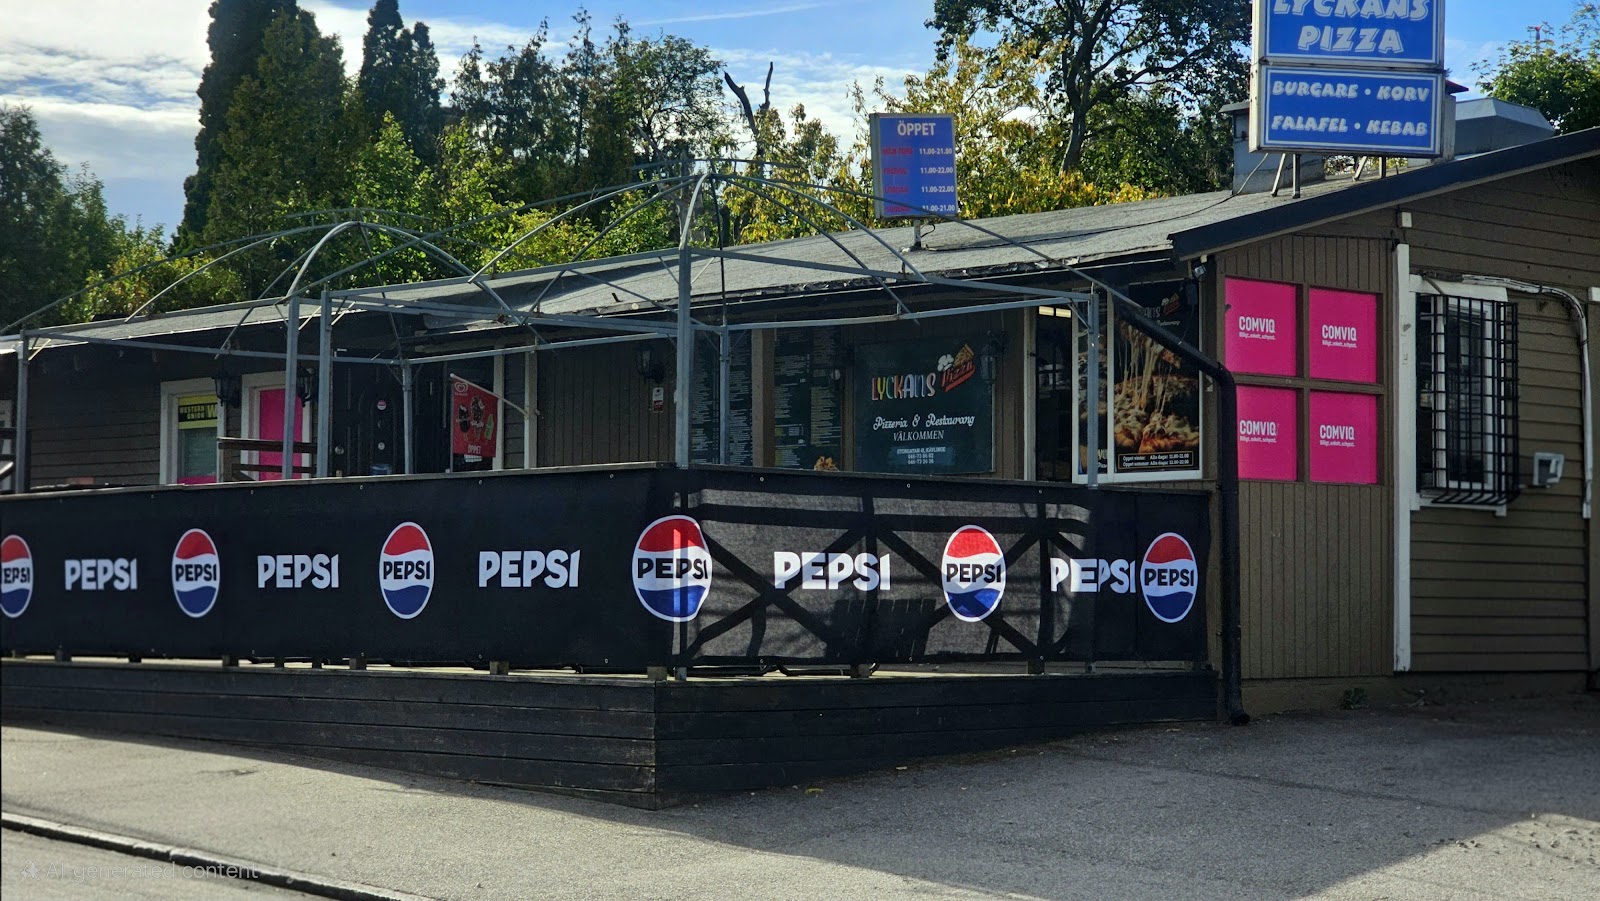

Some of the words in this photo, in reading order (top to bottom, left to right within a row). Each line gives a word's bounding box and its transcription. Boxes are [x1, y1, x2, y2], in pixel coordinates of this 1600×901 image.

[1274, 0, 1429, 21] LYCKANS
[1297, 25, 1404, 54] PIZZA
[1376, 85, 1430, 102] KORV
[897, 120, 936, 136] ÖPPET
[1271, 115, 1348, 133] FALAFEL
[1366, 119, 1428, 137] KEBAB
[921, 185, 955, 193] 11.00-22.00
[1239, 316, 1275, 333] COMVIQ
[1322, 325, 1357, 341] COMVIQ
[873, 416, 908, 430] Pizzeria
[912, 414, 920, 427] &
[925, 413, 976, 428] Restaurang
[1240, 420, 1277, 436] COMVIQ
[893, 430, 944, 441] VÄLKOMMEN
[1320, 425, 1355, 440] COMVIQ
[2, 567, 30, 584] EPSI
[65, 558, 137, 591] PEPSI
[175, 563, 217, 582] PEPSI
[257, 553, 339, 589] PEPSI
[383, 560, 431, 580] PEPSI
[478, 549, 581, 588] PEPSI
[637, 557, 708, 580] PEPSI
[773, 551, 891, 591] PEPSI
[946, 563, 1001, 583] PEPSI
[1050, 558, 1136, 593] PEPSI
[1144, 568, 1194, 587] PEPSI
